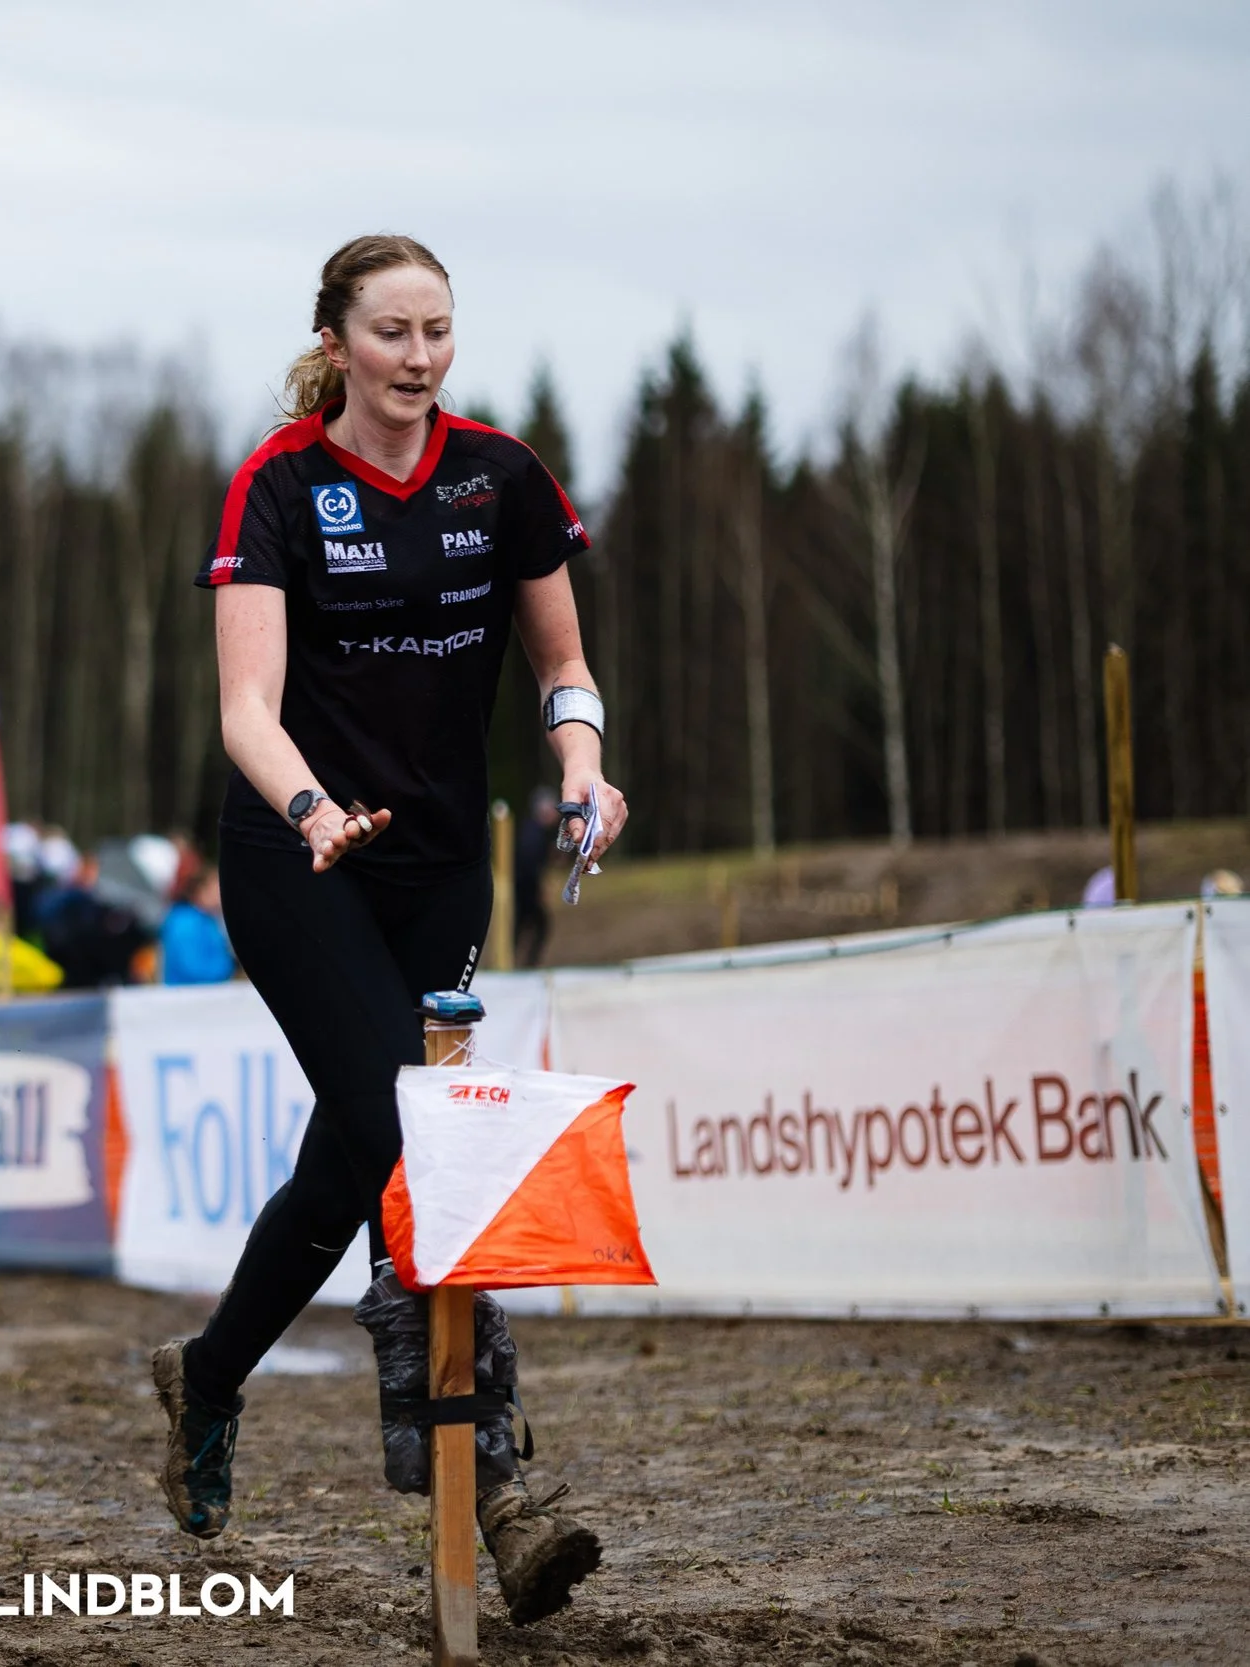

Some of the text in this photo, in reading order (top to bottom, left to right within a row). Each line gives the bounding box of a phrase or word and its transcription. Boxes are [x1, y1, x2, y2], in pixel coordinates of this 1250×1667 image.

[324, 497, 349, 512] C4
[441, 529, 490, 550] PAN-
[323, 540, 385, 560] MAXI
[666, 1068, 1168, 1190] Landshypotek Bank
